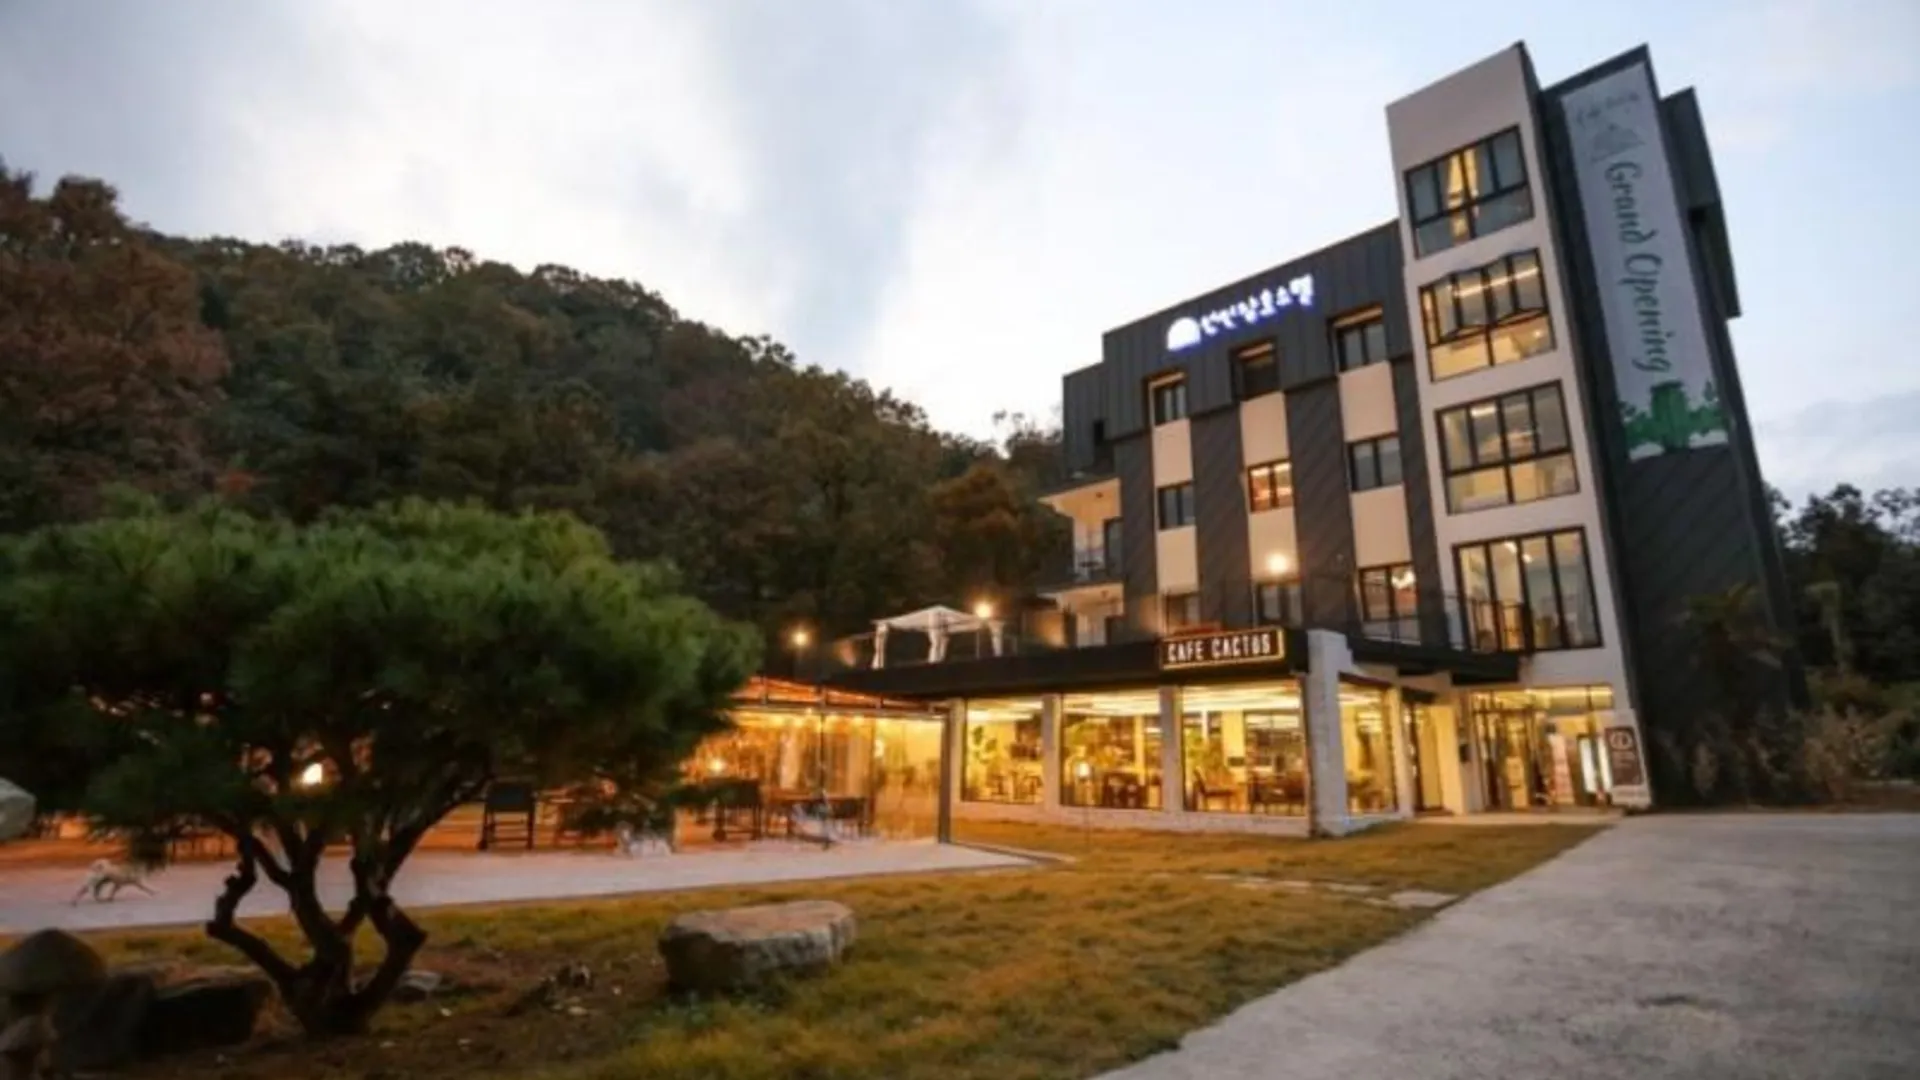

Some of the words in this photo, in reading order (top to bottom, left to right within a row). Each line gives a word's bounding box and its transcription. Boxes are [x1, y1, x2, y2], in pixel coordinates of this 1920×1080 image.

[1604, 161, 1659, 244] Grand
[1618, 253, 1675, 373] Opening
[1168, 640, 1205, 663] CAFE
[1212, 632, 1271, 660] CACTUS
